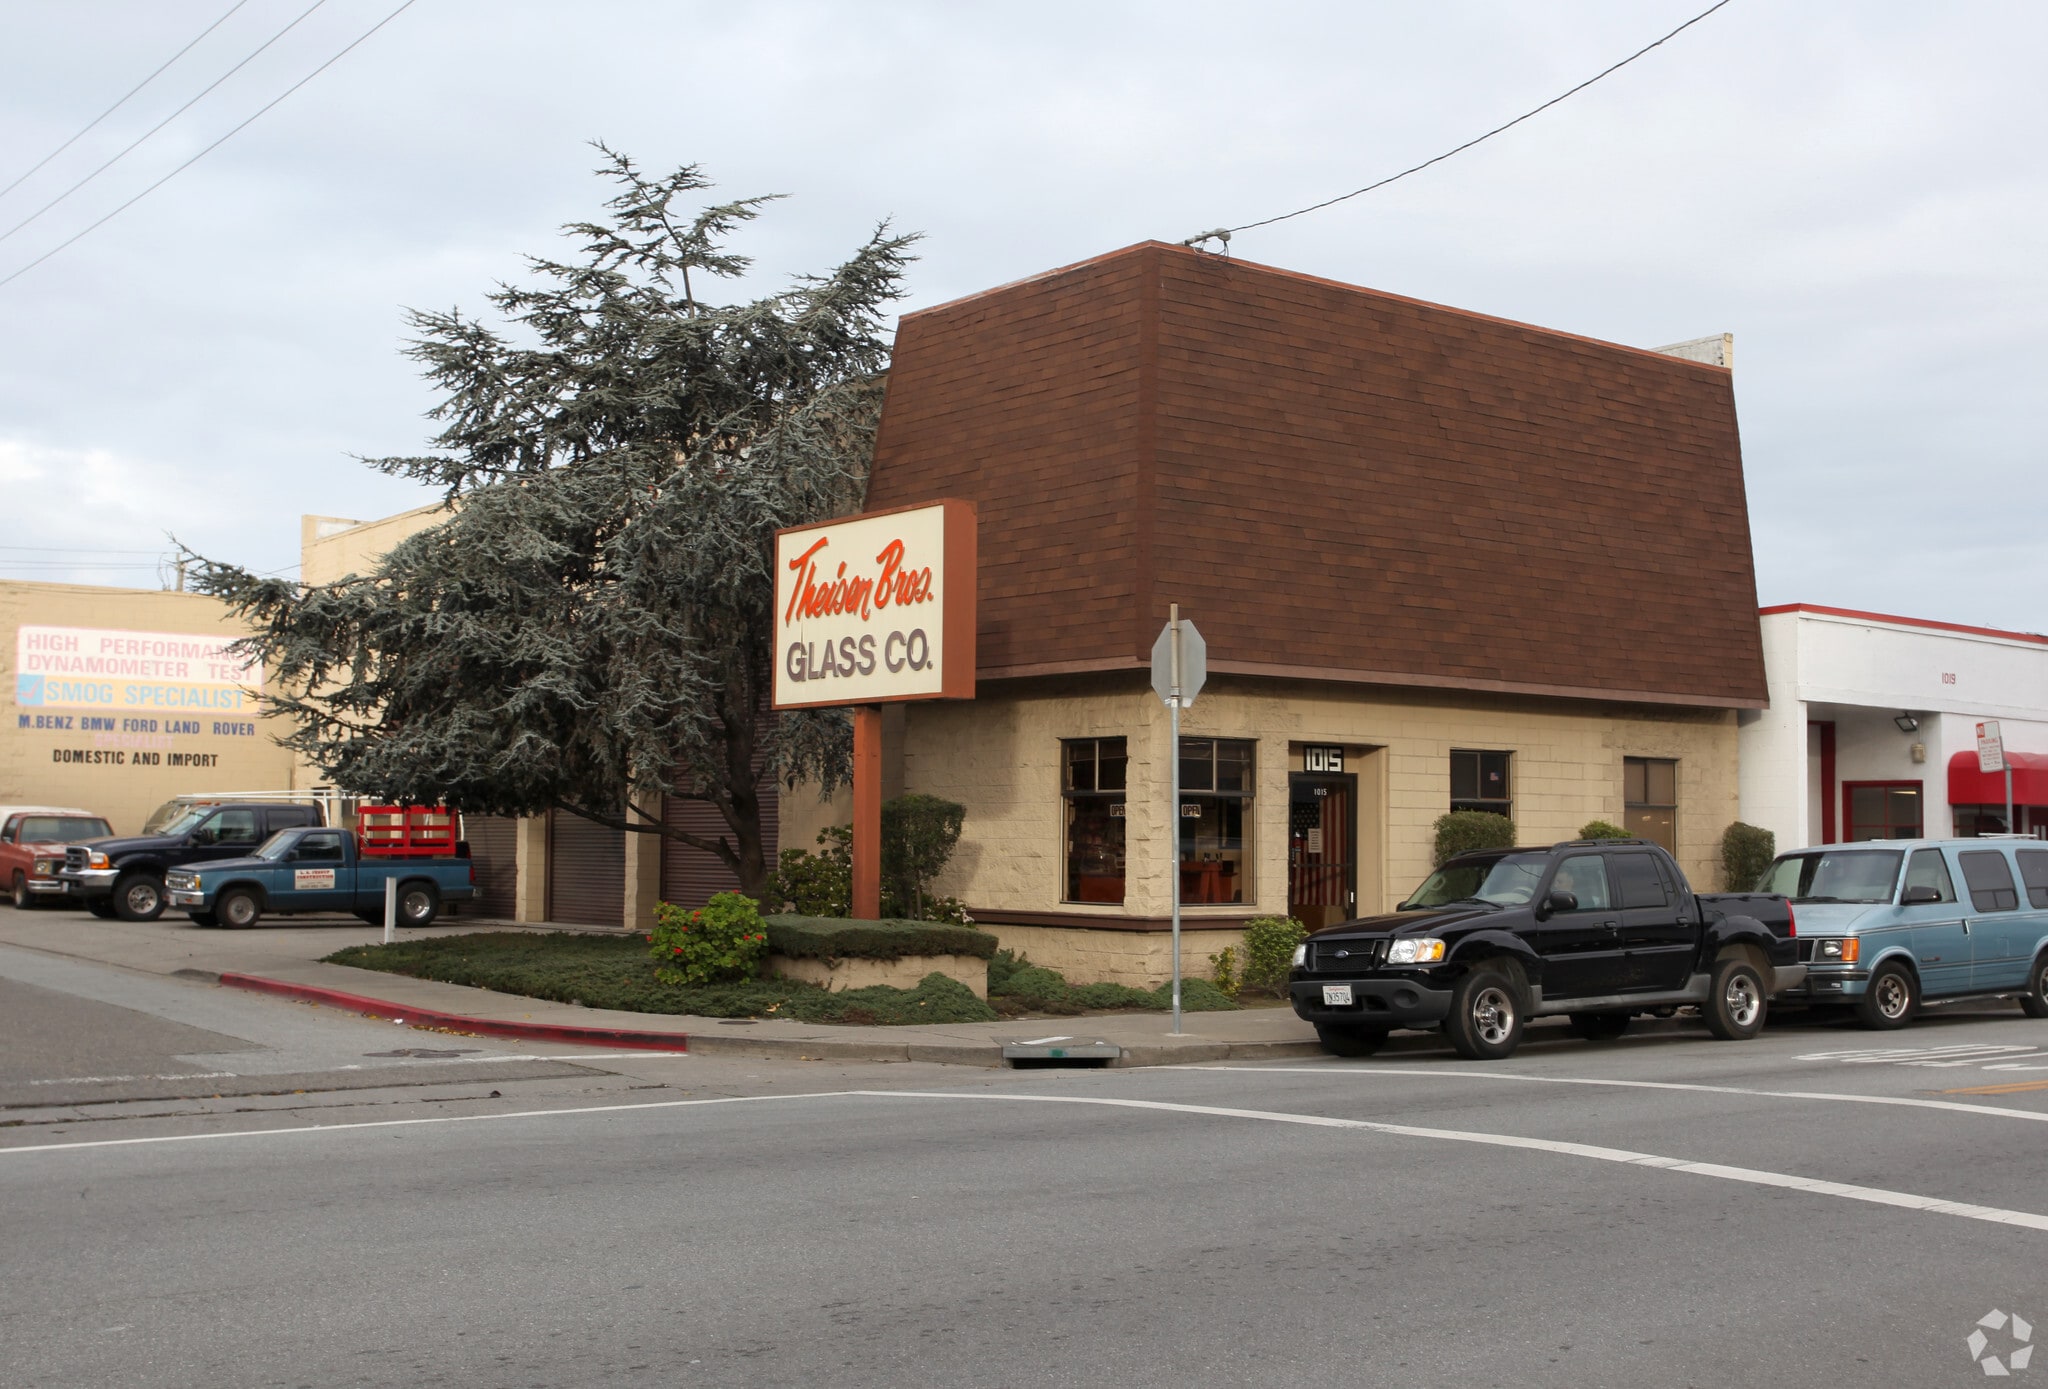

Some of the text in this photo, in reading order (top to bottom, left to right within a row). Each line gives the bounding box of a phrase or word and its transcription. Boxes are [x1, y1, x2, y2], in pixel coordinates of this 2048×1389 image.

[785, 536, 934, 628] Theisen Bros.
[26, 634, 79, 652] HIGH
[27, 654, 252, 681] DYNAMOMETER TEST
[786, 628, 934, 683] GLASS CO.
[1941, 671, 1956, 685] 1019
[46, 681, 244, 709] SMOG SPECIALIST
[18, 714, 255, 737] M.BENZ BMW FORD LAND ROVER
[53, 749, 219, 768] DOMESTIC AND IMPORT
[1305, 747, 1343, 772] 1015
[1313, 787, 1328, 796] 1015
